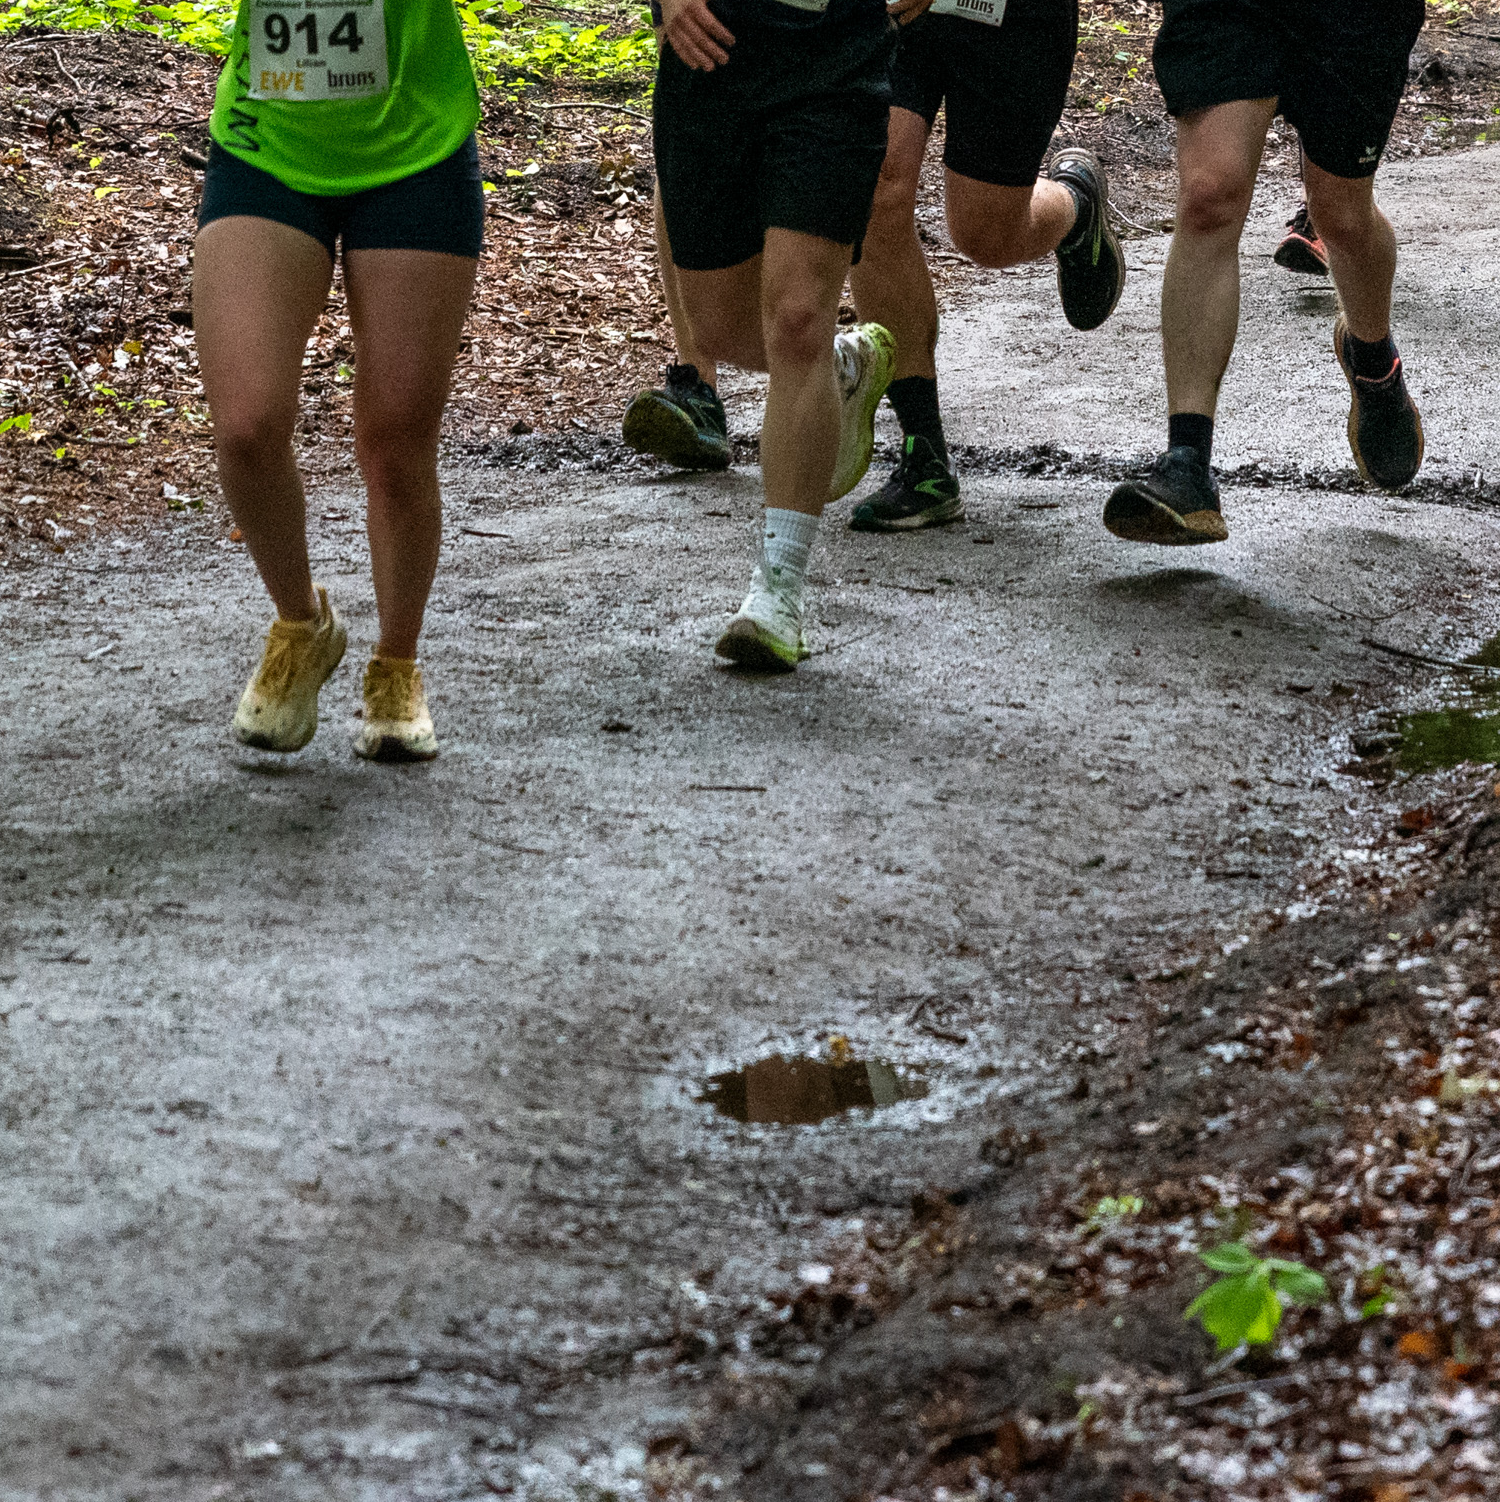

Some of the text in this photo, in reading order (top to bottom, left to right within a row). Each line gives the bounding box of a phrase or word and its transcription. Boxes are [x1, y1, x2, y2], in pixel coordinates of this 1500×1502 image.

[264, 11, 364, 54] 914
[260, 70, 304, 92] EWE
[327, 69, 375, 87] bruns
